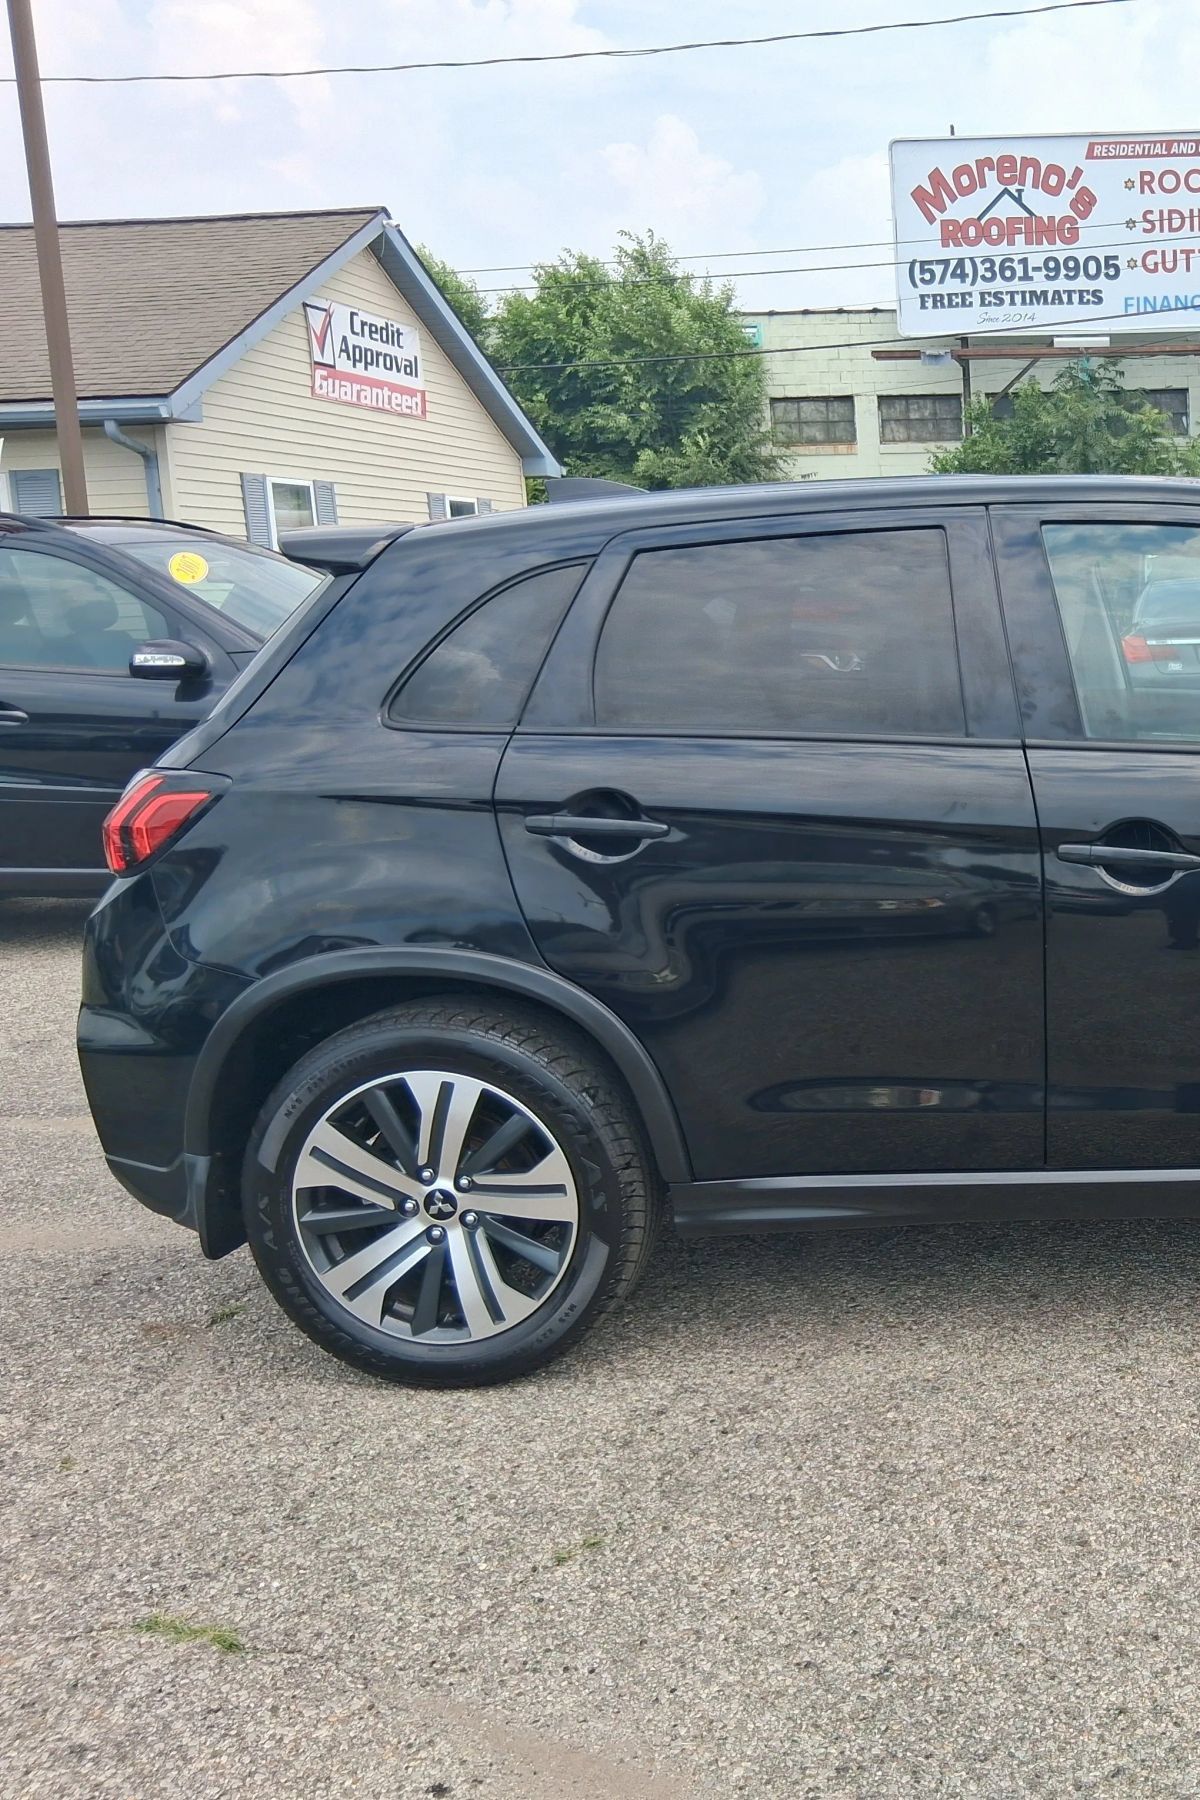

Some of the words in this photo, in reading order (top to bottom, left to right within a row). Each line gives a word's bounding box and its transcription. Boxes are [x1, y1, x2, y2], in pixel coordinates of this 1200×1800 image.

[1093, 143, 1168, 157] RESIDENTIAL
[1171, 142, 1196, 154] AND
[911, 155, 1098, 226] Moreno's
[940, 215, 1080, 248] ROOFING
[908, 255, 1121, 289] (574)361-9905
[919, 292, 974, 310] FREE
[979, 289, 1104, 307] ESTIMATES
[349, 312, 404, 349] Credit
[977, 312, 1000, 324] Since
[1001, 312, 1037, 324] 2014
[338, 335, 418, 378] Approval
[315, 369, 421, 416] Guaranteed
